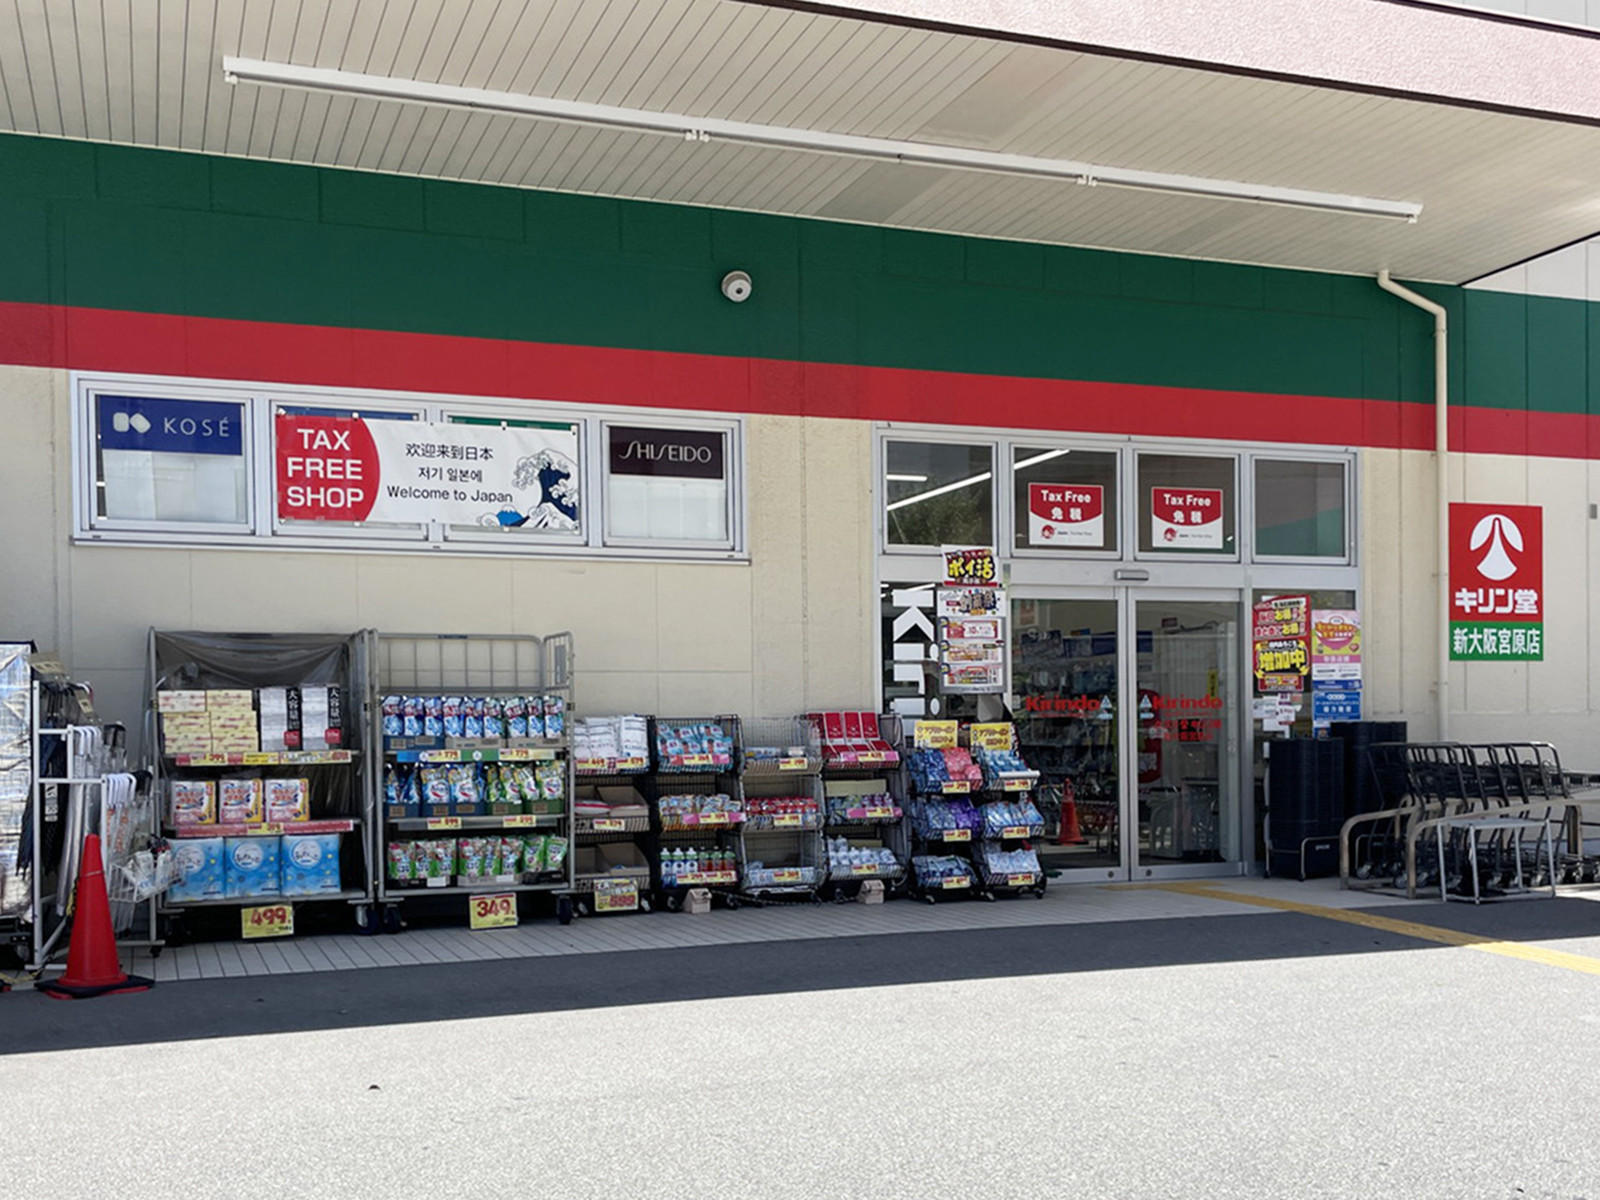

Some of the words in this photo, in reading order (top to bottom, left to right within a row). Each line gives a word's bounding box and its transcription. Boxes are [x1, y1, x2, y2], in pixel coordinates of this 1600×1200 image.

[163, 417, 230, 437] KOSÉ
[297, 428, 351, 451] TAX
[405, 442, 494, 461] 欢迎来到日本
[618, 440, 713, 464] SHISEIDO
[286, 456, 363, 481] FREE
[418, 466, 443, 481] 저기
[446, 467, 483, 483] 일본에
[286, 486, 364, 509] SHOP
[386, 484, 450, 501] Welcome
[453, 488, 468, 501] to
[470, 489, 514, 503] Japan
[1041, 489, 1063, 503] Tax
[1065, 491, 1092, 504] Free
[1163, 493, 1185, 507] Tax
[1186, 494, 1212, 507] Free
[948, 556, 993, 579] ポイ活
[1455, 587, 1538, 614] キリン堂
[1453, 627, 1540, 655] 新大阪宮原店
[1025, 694, 1100, 712] Kirindo
[1152, 693, 1223, 711] Kirindo
[251, 906, 287, 925] 499
[477, 899, 511, 917] 349
